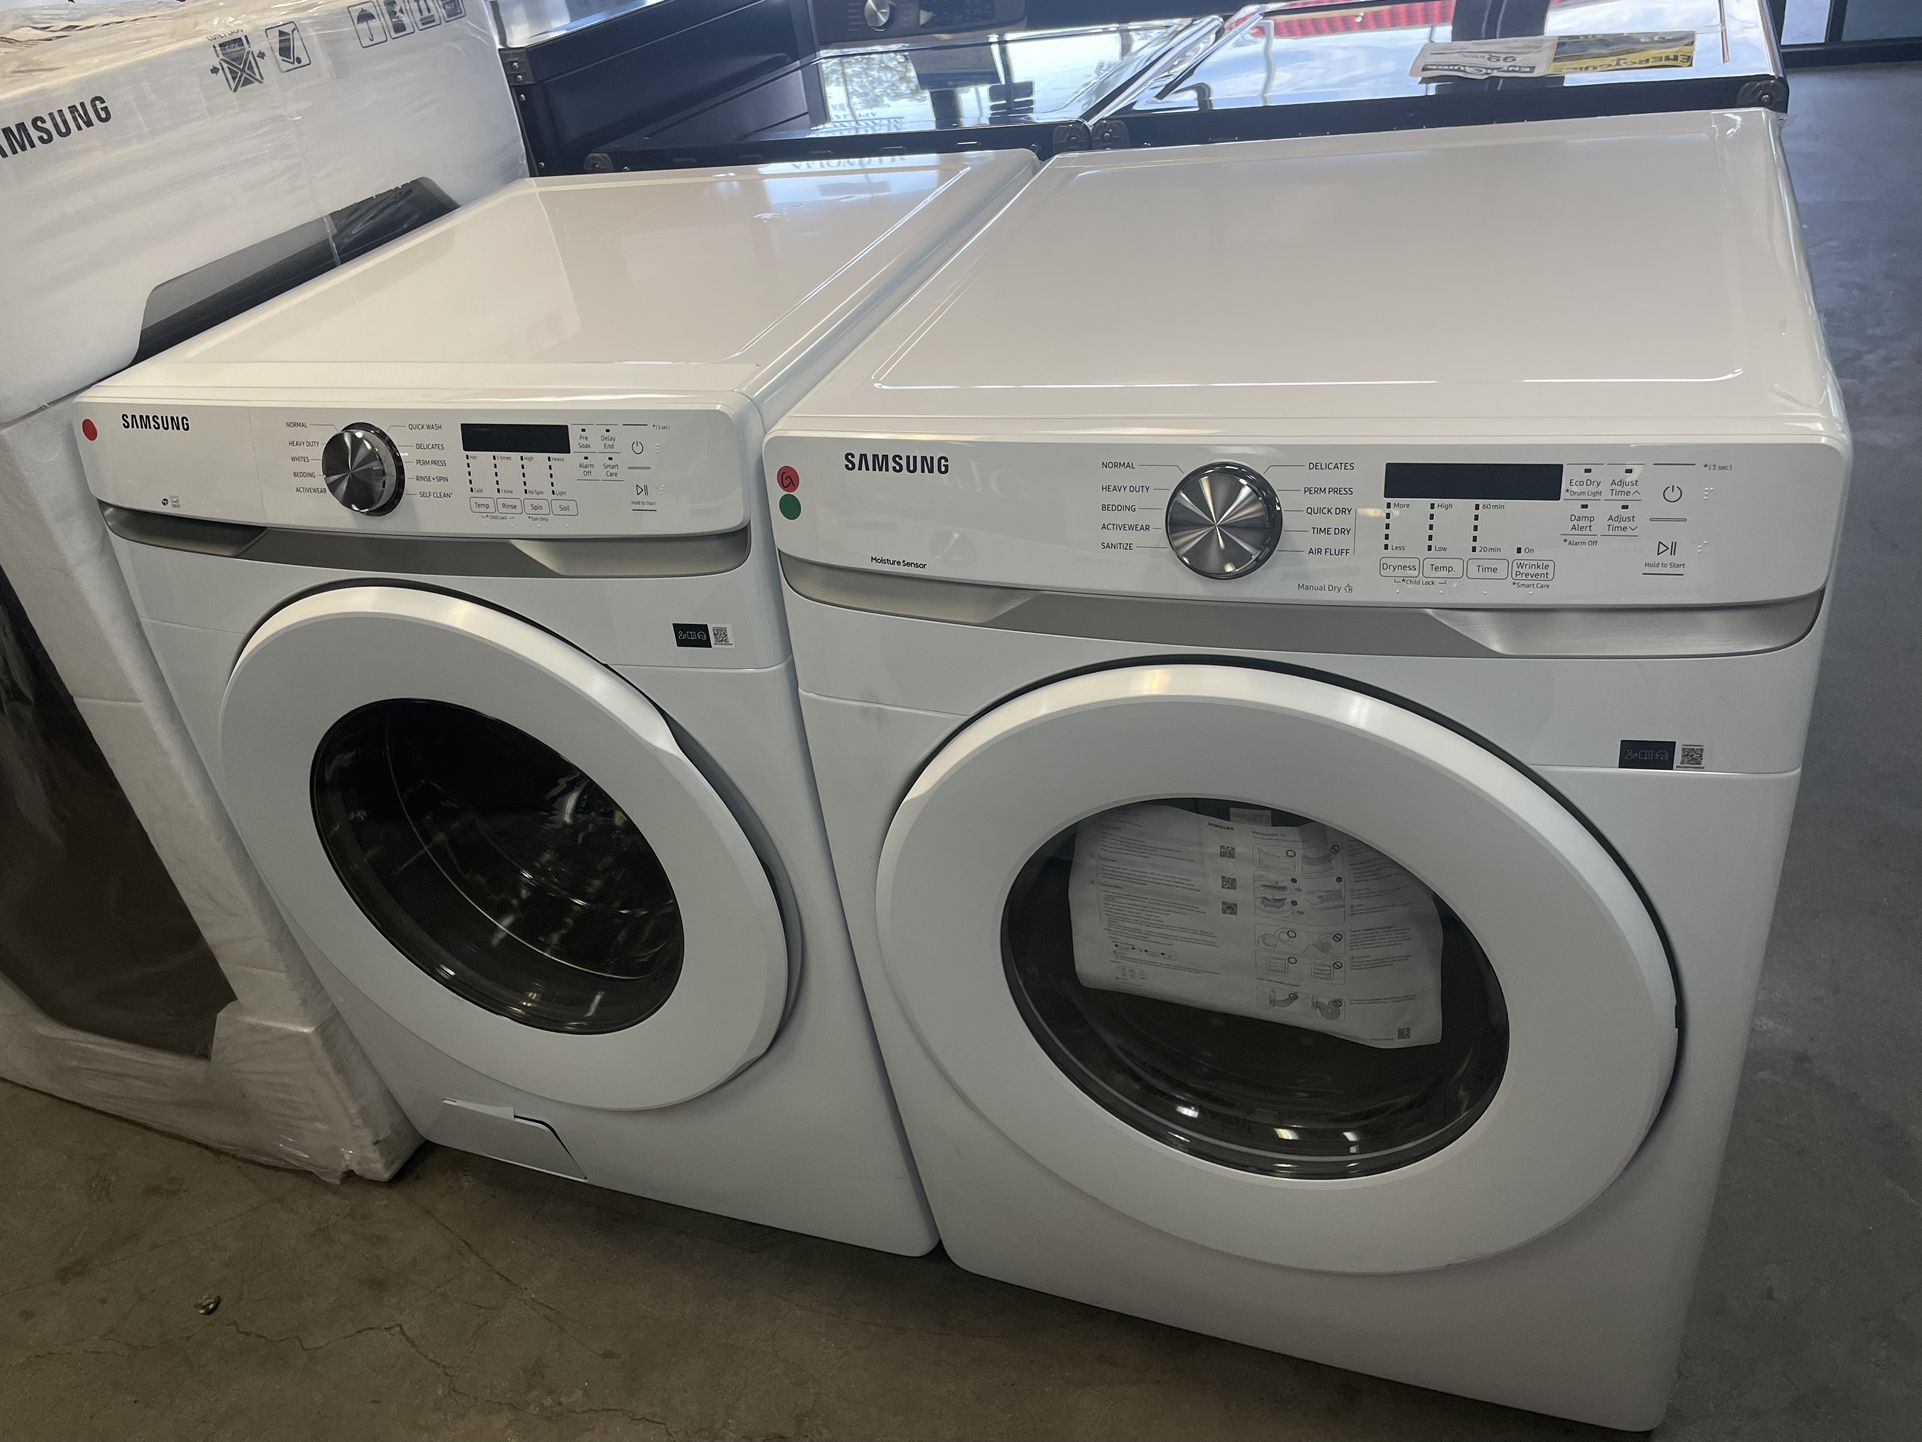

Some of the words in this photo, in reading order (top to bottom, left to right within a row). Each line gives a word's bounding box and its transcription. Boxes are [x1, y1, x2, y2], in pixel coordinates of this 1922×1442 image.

[121, 413, 190, 431] SAMSUNG
[408, 423, 425, 431] QUICK
[425, 423, 442, 431] WASH
[600, 434, 616, 443] Delay
[603, 442, 615, 450] End
[290, 455, 310, 463] WHITES
[430, 459, 447, 467] PRESS
[844, 452, 950, 475] SAMSUNG
[602, 462, 619, 470] Smart
[1101, 461, 1136, 469] NORMAL
[1308, 462, 1355, 471] DELICATES
[292, 471, 316, 479] BEDDING
[605, 470, 618, 478] Care
[435, 475, 449, 483] SPIN
[1569, 478, 1585, 487] Eco
[1585, 478, 1601, 488] Dry
[1609, 478, 1639, 488] Adjust
[295, 486, 328, 494] ACTIVEWEAR
[1101, 484, 1128, 492] HEAVY
[1129, 485, 1150, 493] DUTY
[1303, 486, 1327, 495] PERM
[1327, 486, 1354, 496] PRESS
[1609, 488, 1632, 497] Time
[1587, 490, 1602, 498] Light
[501, 502, 518, 510] Rinse
[530, 503, 544, 511] Spin
[558, 504, 571, 512] Soil
[1101, 503, 1137, 513] BEDDING
[1437, 502, 1453, 510] High
[1306, 506, 1333, 516] QUICK
[1334, 507, 1353, 515] DRY
[1569, 514, 1595, 523] Damp
[1606, 514, 1636, 524] Adjust
[1101, 523, 1151, 532] ACTIVEWEAR
[1311, 526, 1333, 536] TIME
[1333, 527, 1352, 536] DRY
[1570, 524, 1593, 532] Alert
[1606, 524, 1628, 533] Time
[1101, 542, 1134, 551] SANITIZE
[1587, 539, 1598, 547] Off
[1307, 547, 1323, 556] AIR
[1324, 548, 1351, 557] FLUFF
[1391, 544, 1406, 552] Less
[870, 555, 902, 567] Moisture
[901, 559, 928, 570] Sensor
[1381, 562, 1417, 572] Dryness
[1516, 561, 1550, 570] Wrinkle
[1429, 563, 1455, 574] Temp.
[1476, 564, 1498, 574] Time
[1515, 570, 1549, 579] Prevent
[1297, 583, 1326, 592] Manual
[1327, 584, 1342, 593] Dry
